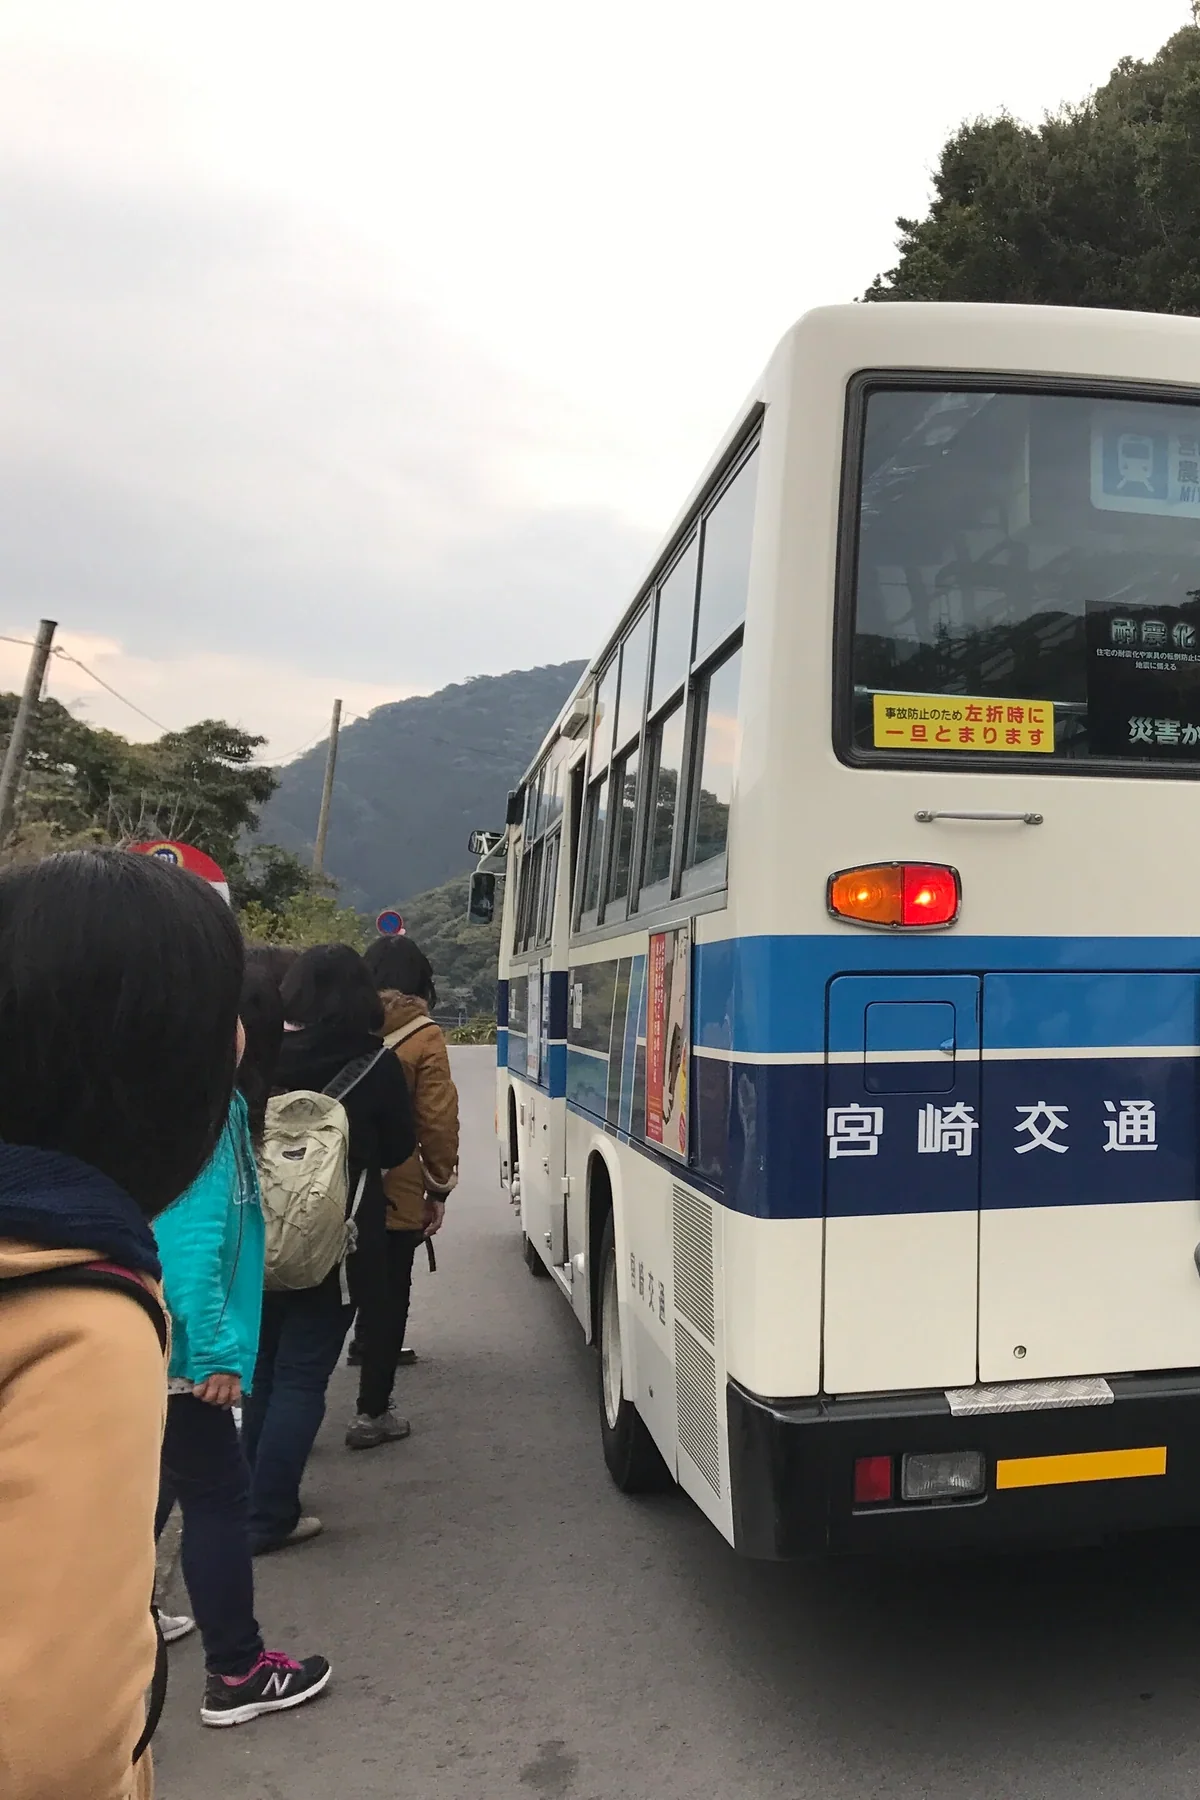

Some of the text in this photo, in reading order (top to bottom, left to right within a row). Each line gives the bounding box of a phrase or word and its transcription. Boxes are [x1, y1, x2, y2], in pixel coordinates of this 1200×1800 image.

[1111, 619, 1197, 649] 耐震化
[885, 725, 1045, 746] 一旦とまります
[826, 1099, 1158, 1159] 宮崎交通
